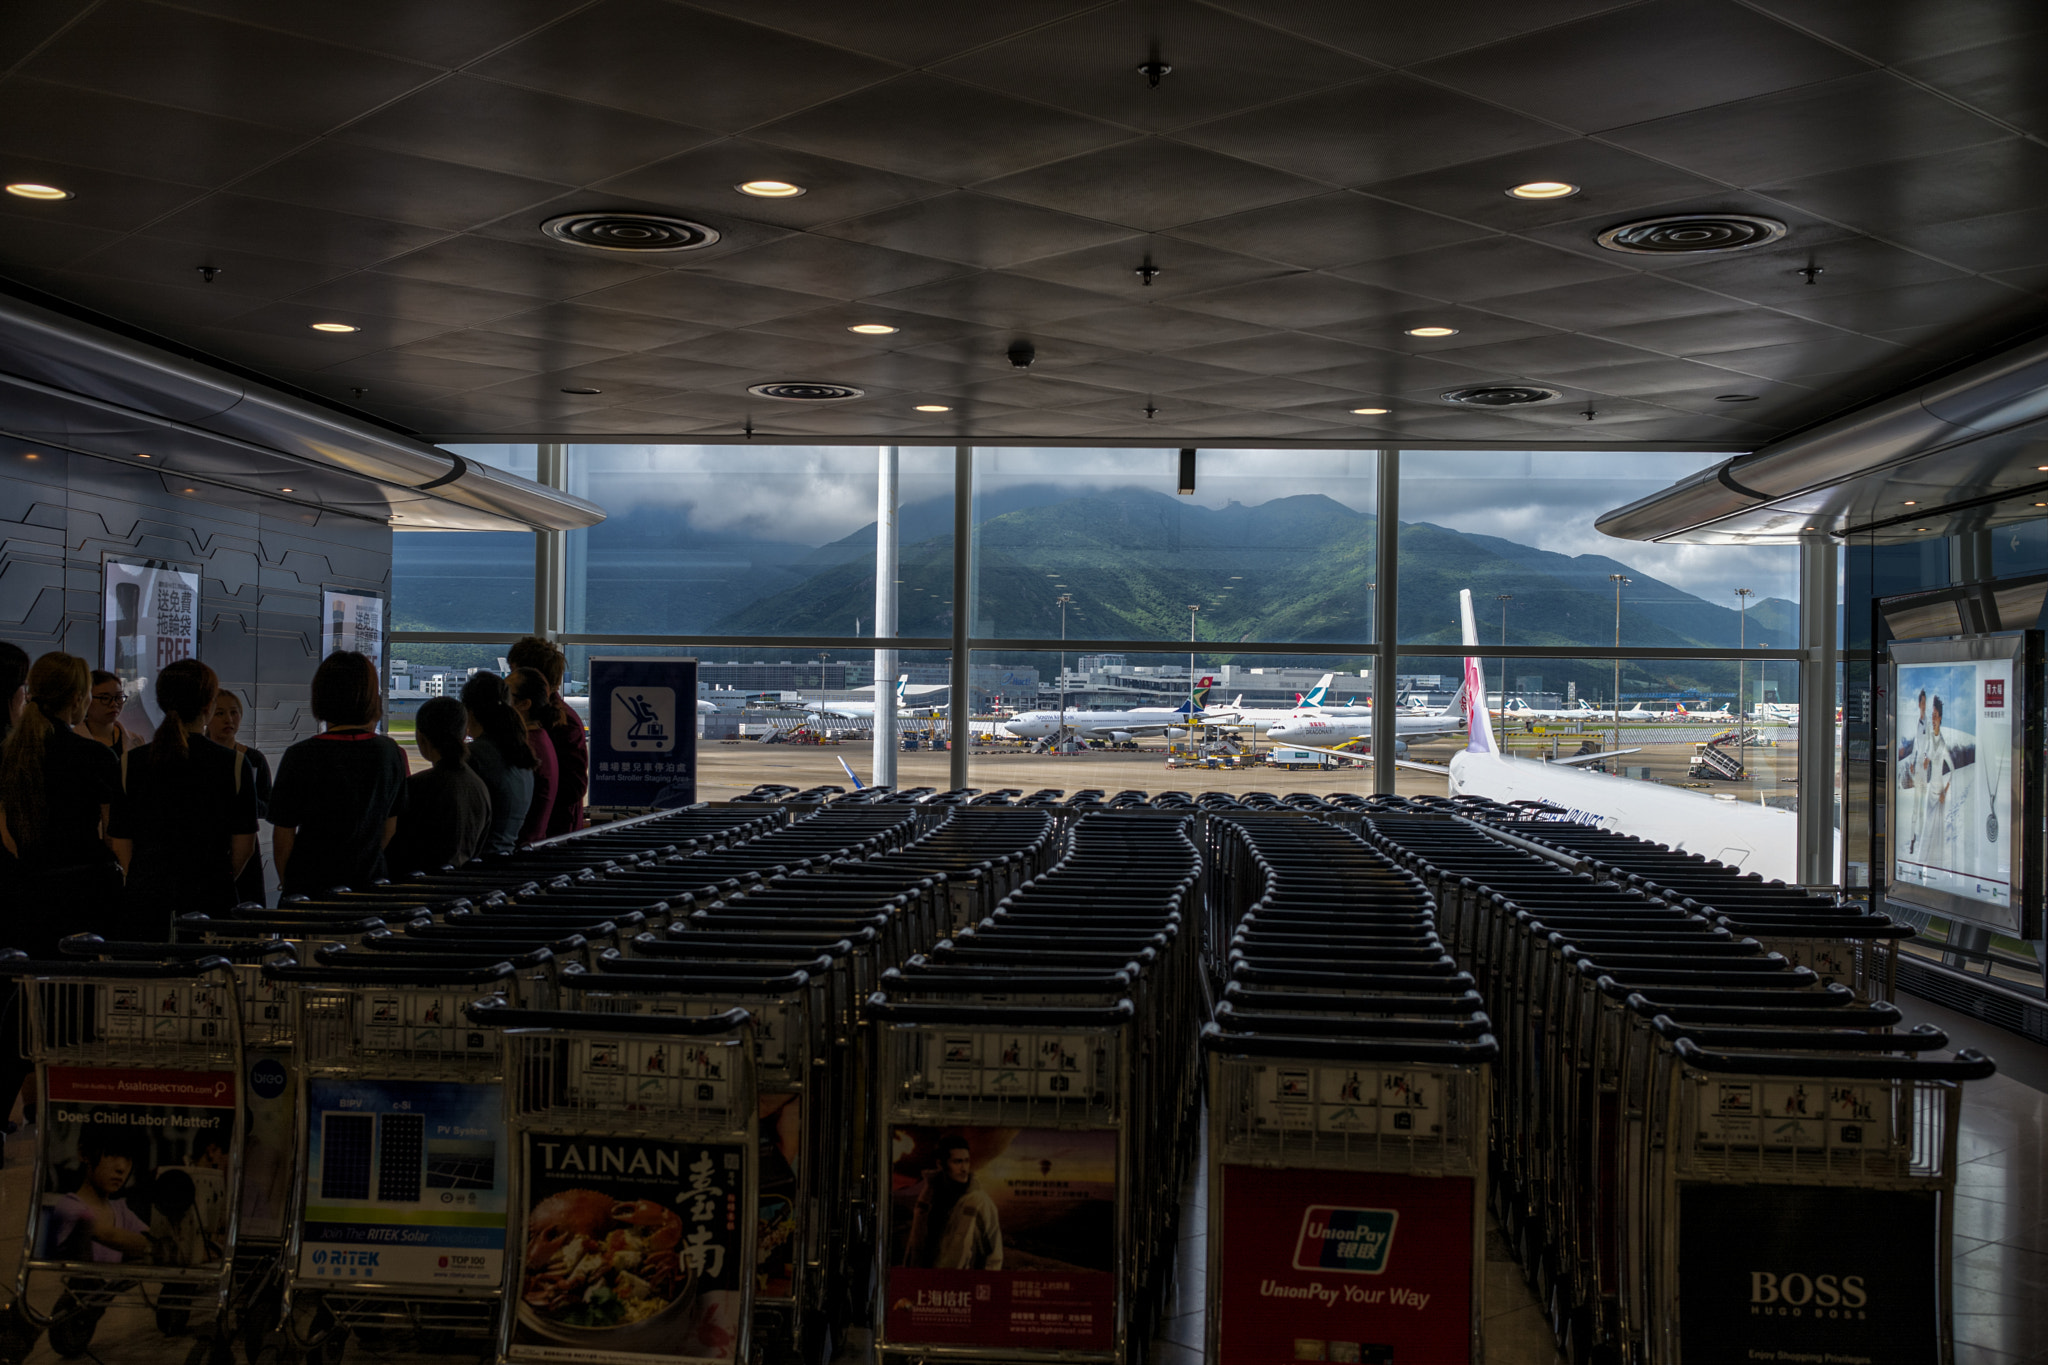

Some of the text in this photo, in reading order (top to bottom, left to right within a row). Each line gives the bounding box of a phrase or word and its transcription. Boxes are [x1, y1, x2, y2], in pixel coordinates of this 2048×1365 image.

[157, 588, 192, 613] 送免費
[156, 637, 191, 668] FREE
[595, 773, 616, 782] Infant
[617, 773, 643, 782] Stroller
[644, 774, 671, 784] Staging
[253, 1071, 284, 1085] breo
[339, 1099, 363, 1108] BIPV
[57, 1109, 220, 1129] Does Child Labor Matter?
[437, 1125, 488, 1137] PV System
[537, 1142, 680, 1177] TAINAN
[675, 1150, 726, 1279] 臺南
[319, 1228, 342, 1240] Join
[346, 1228, 366, 1240] The
[366, 1228, 399, 1241] RITEK
[401, 1229, 430, 1243] Solar
[1307, 1221, 1387, 1248] UnionPay
[451, 1255, 486, 1265] TOP 100
[917, 1289, 972, 1308] 上海信托
[1259, 1279, 1431, 1311] UnionPay Your Way
[1749, 1271, 1868, 1309] BOSS
[1750, 1305, 1867, 1320] HUGO BOSS
[1748, 1348, 1776, 1361] Enjoy
[1777, 1349, 1824, 1364] Shopping
